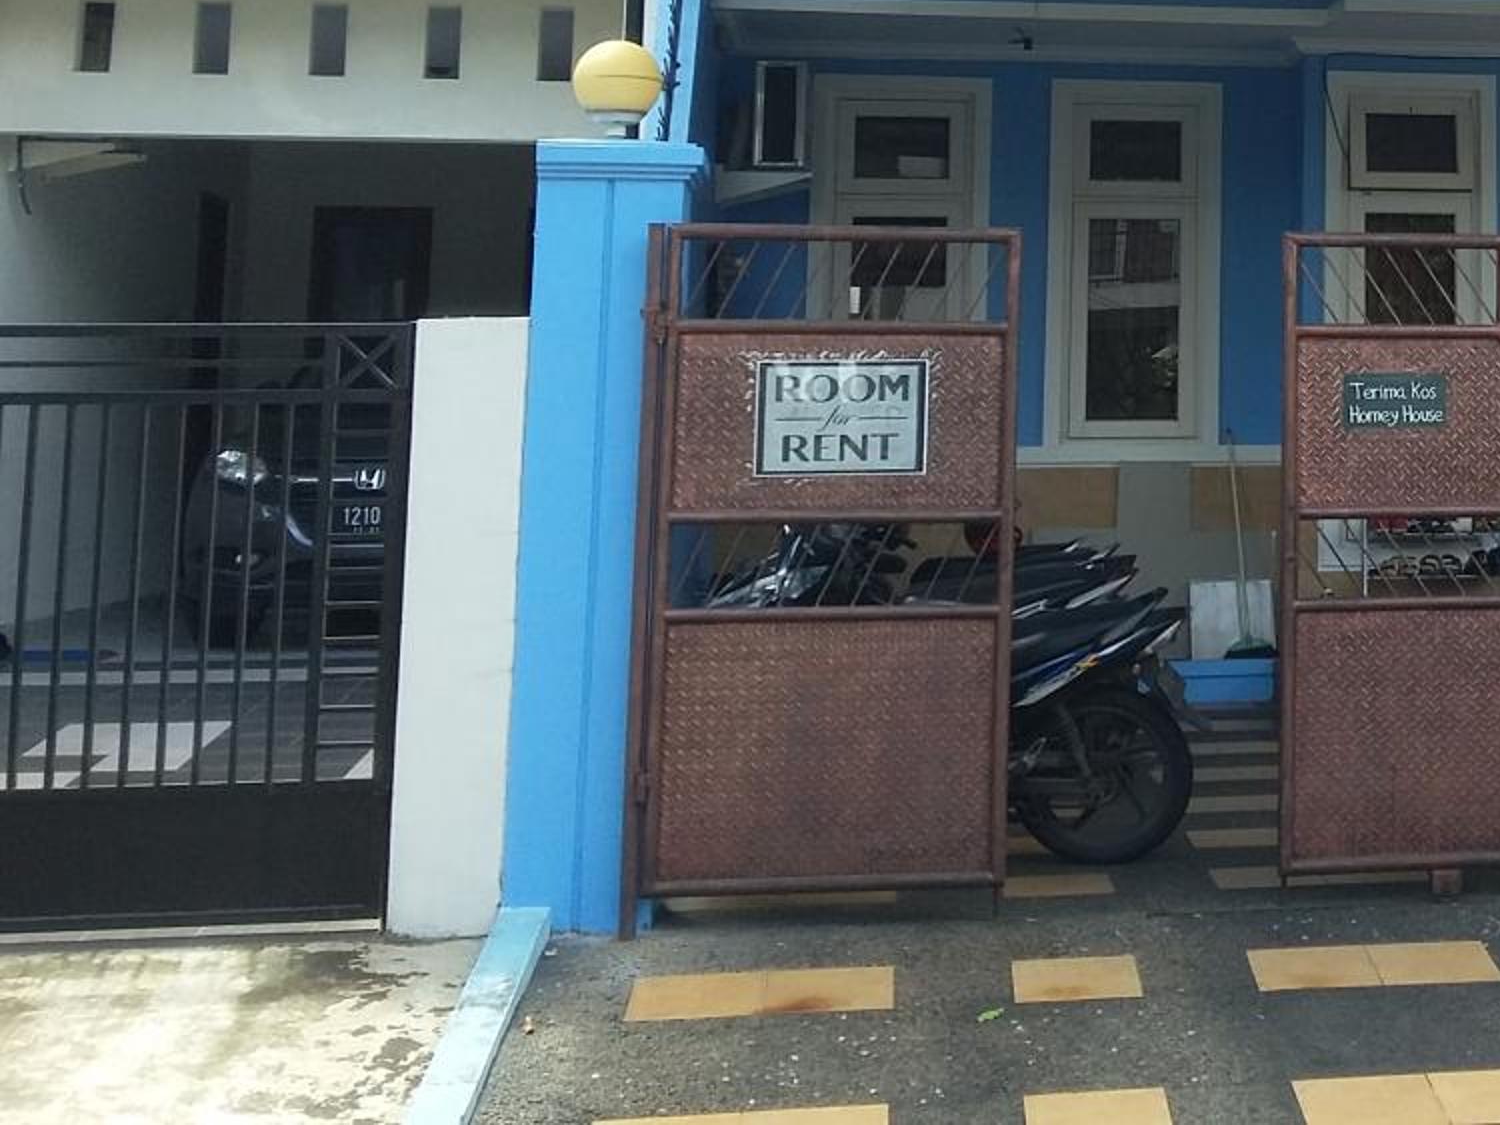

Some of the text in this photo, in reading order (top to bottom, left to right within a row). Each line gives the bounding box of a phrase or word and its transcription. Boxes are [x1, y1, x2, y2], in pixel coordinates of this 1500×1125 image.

[775, 374, 911, 403] ROOM
[1349, 381, 1437, 400] Terima Kos
[816, 404, 852, 431] for
[1349, 404, 1444, 427] Homey House
[782, 433, 900, 462] RENT
[344, 506, 381, 526] 1210
